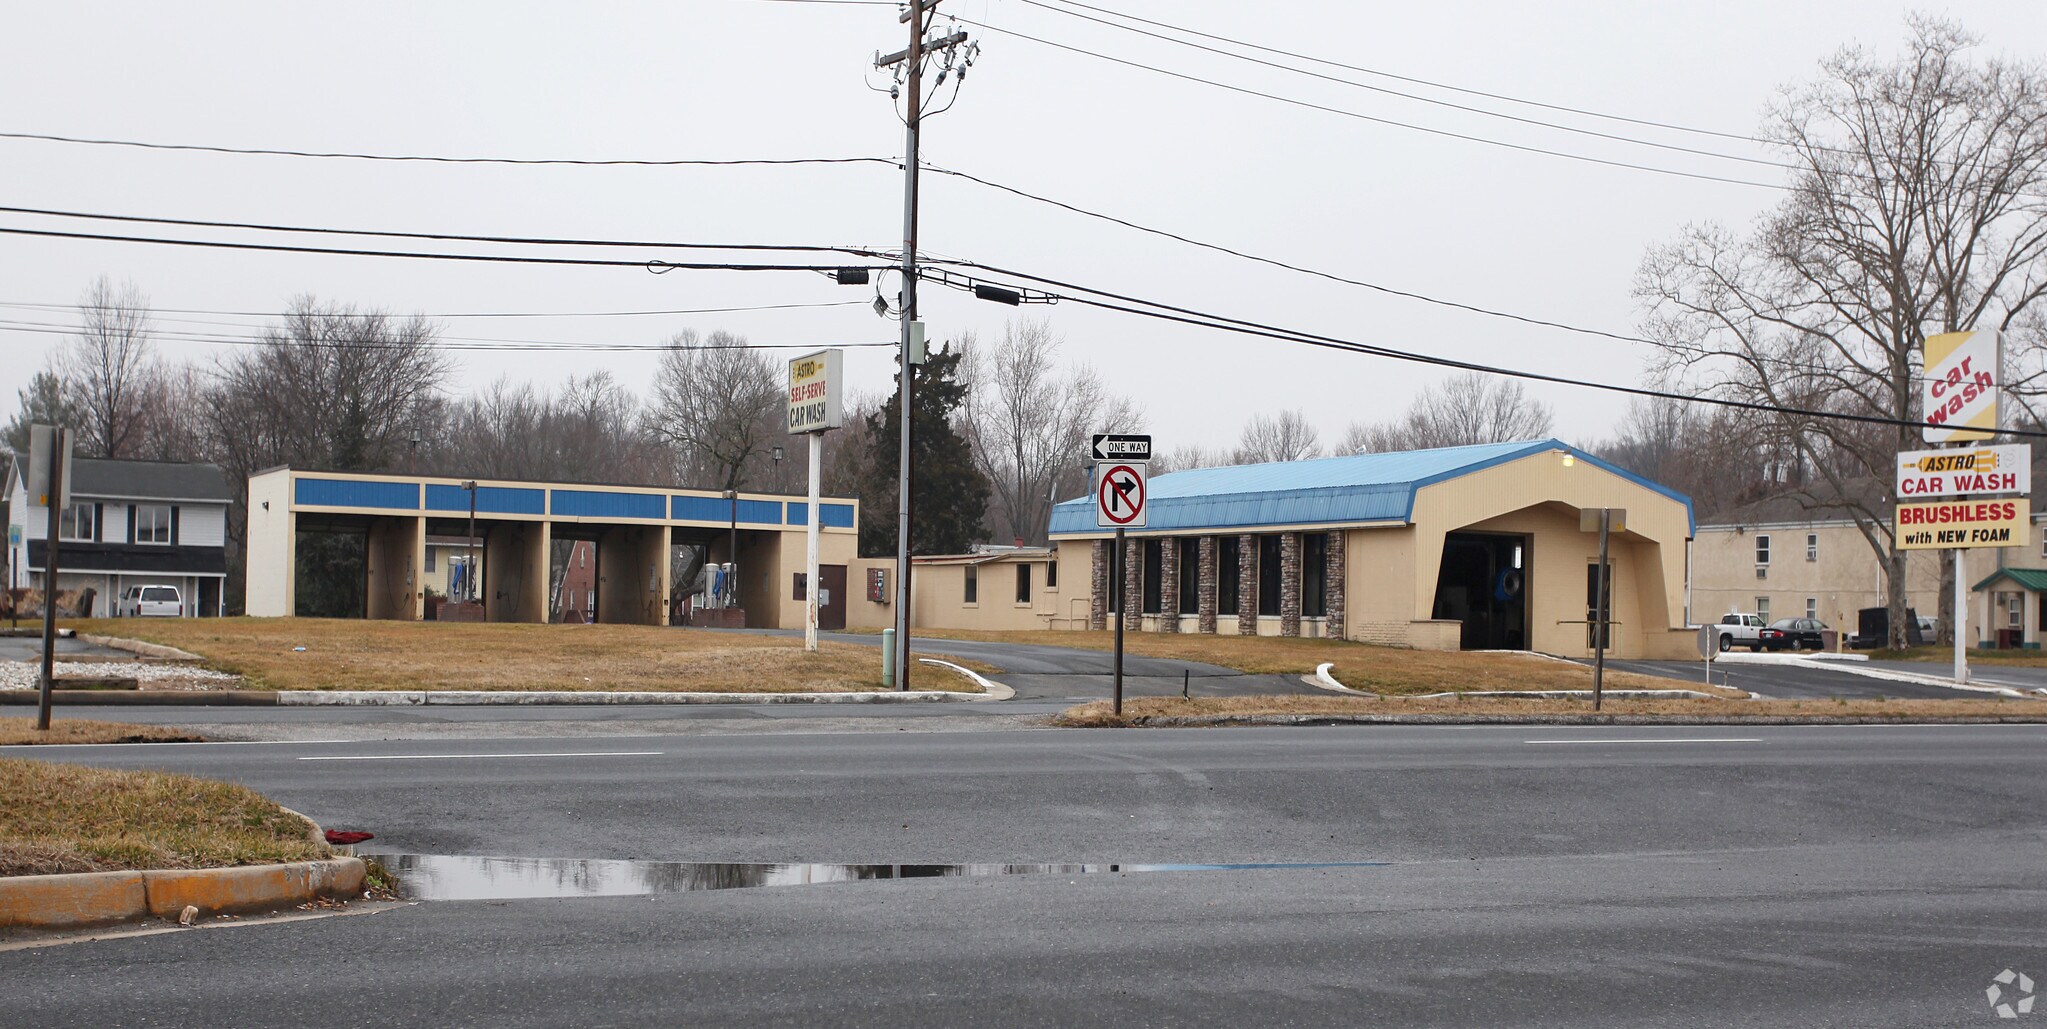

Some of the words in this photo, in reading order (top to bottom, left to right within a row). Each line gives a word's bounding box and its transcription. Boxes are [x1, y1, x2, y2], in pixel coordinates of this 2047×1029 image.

[797, 361, 815, 378] ASTRO
[1931, 355, 1972, 399] car
[791, 381, 825, 402] SELF-SERVE
[1926, 370, 1994, 430] wash
[790, 406, 805, 428] CAR
[806, 402, 825, 424] WASH
[1108, 442, 1125, 452] ONE
[1129, 442, 1147, 452] WAY
[1925, 454, 1976, 472] ASTRO
[1901, 477, 1943, 495] CAR
[1954, 473, 2016, 491] WASH
[1900, 503, 2016, 525] BRUSHLESS
[1905, 531, 1932, 544] with
[1937, 530, 1967, 543] NEW
[1971, 528, 2010, 542] FOAM
